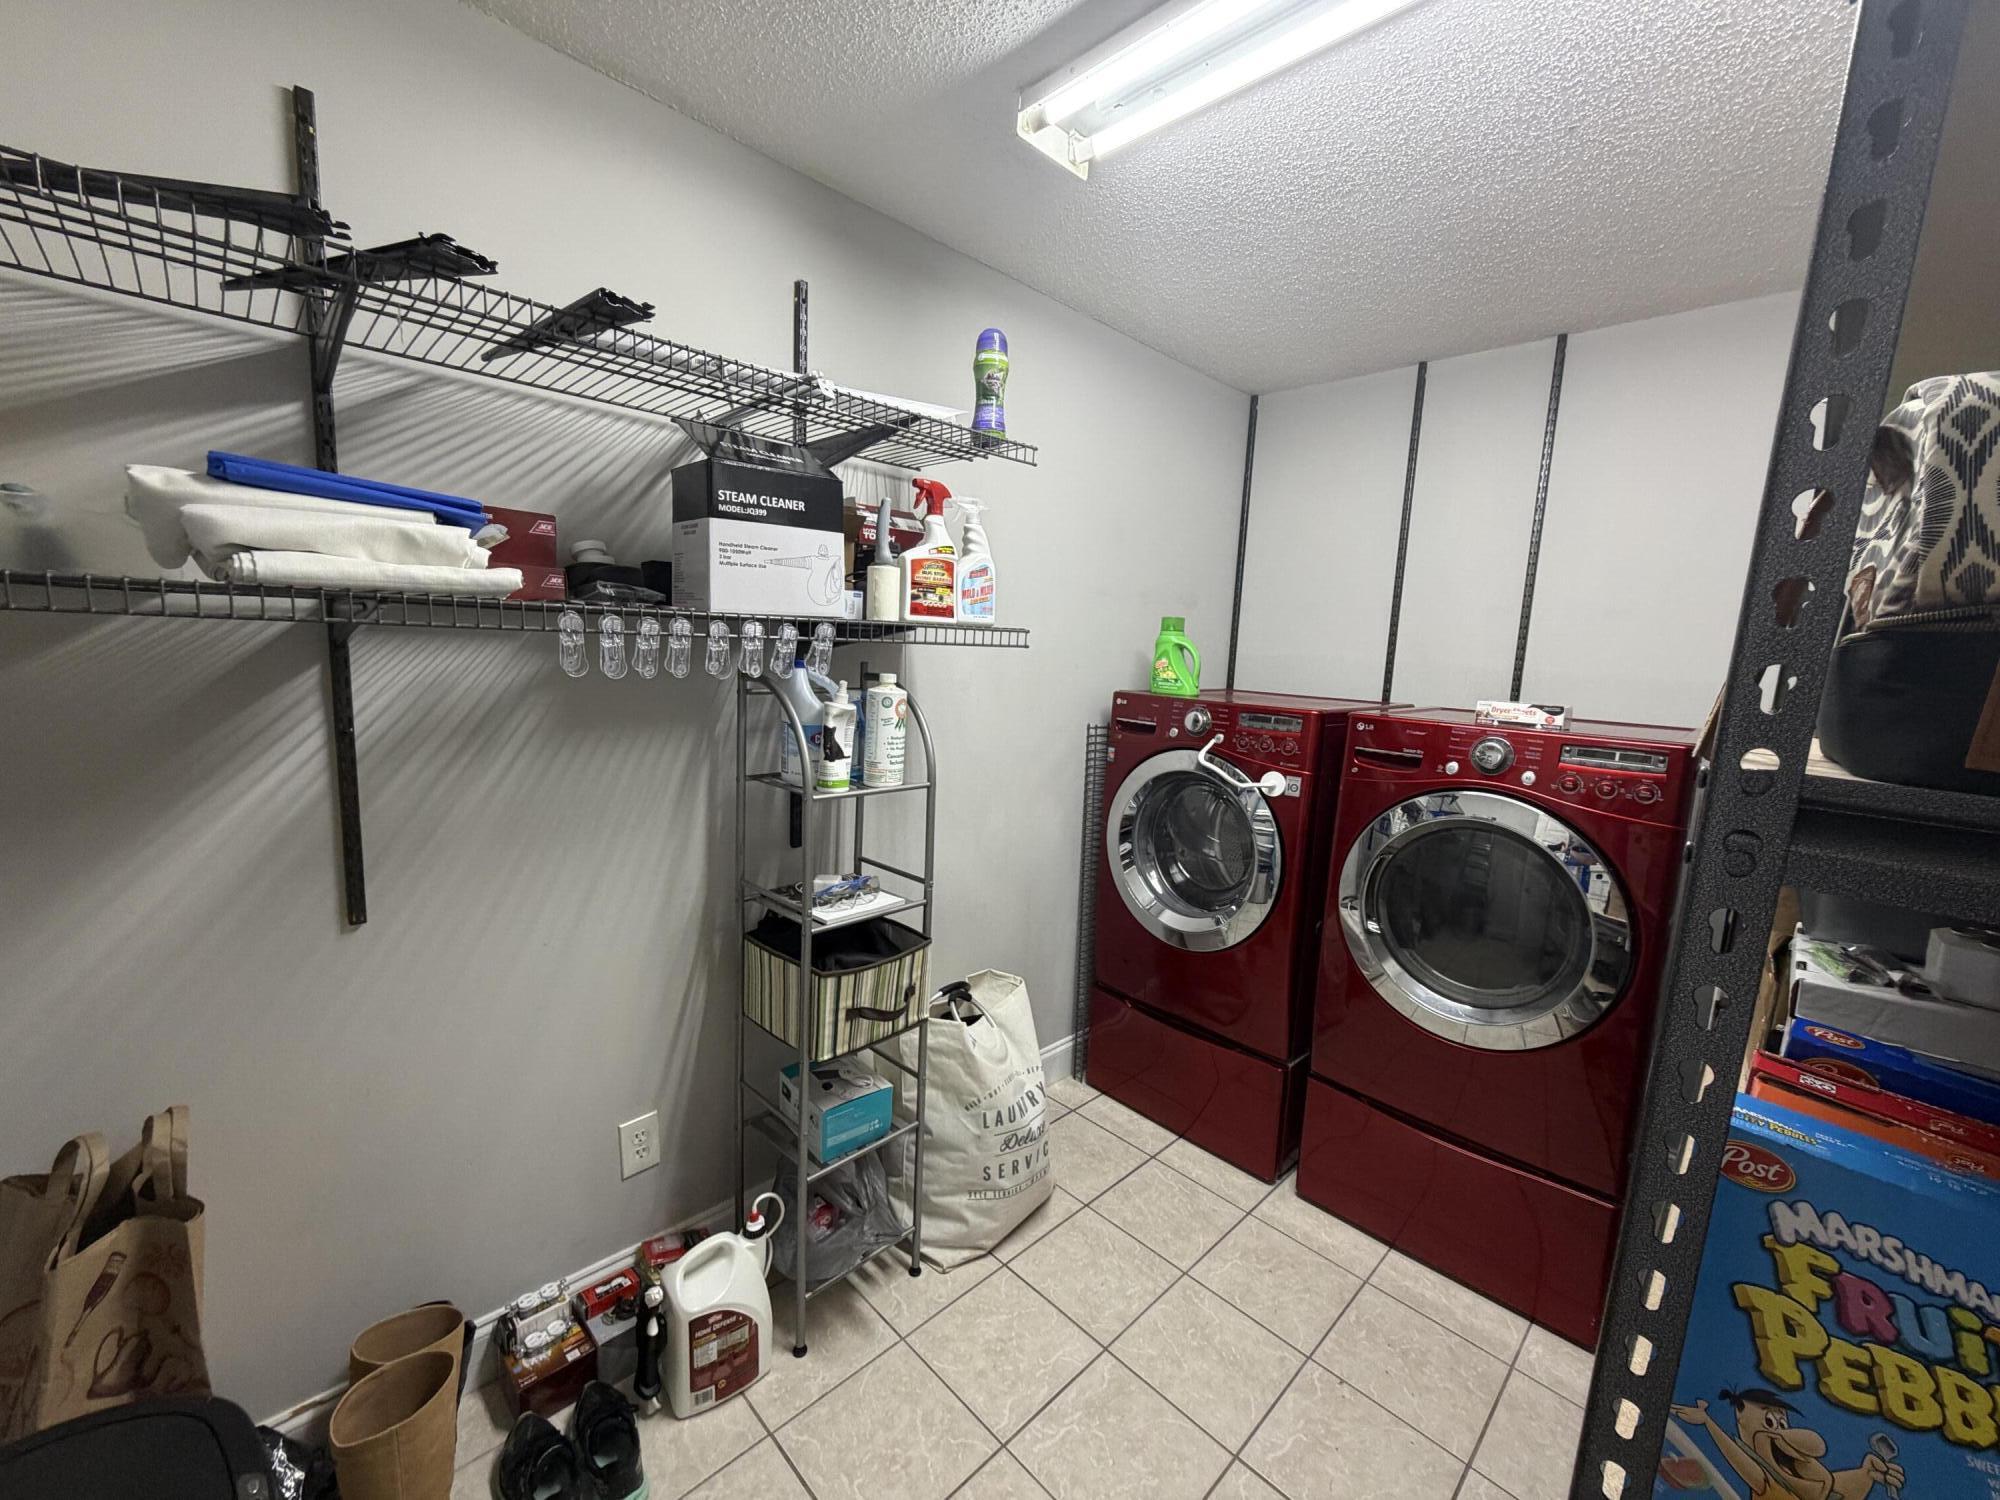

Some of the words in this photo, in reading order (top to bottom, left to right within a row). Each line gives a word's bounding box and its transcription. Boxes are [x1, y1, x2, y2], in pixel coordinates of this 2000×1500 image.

[718, 489, 757, 505] STEAM
[760, 495, 806, 512] CLEANER
[718, 504, 767, 516] MODEL:JQ399
[718, 541, 743, 549] Handheld
[759, 544, 779, 552] Cleaner
[718, 560, 738, 568] Multiple
[739, 561, 758, 569] Surface
[1490, 705, 1511, 715] Dryer
[1812, 1027, 1855, 1047] Post
[983, 1141, 1049, 1182] SERVIC
[1720, 1150, 1781, 1182] Post
[1731, 1282, 2000, 1449] PEBB
